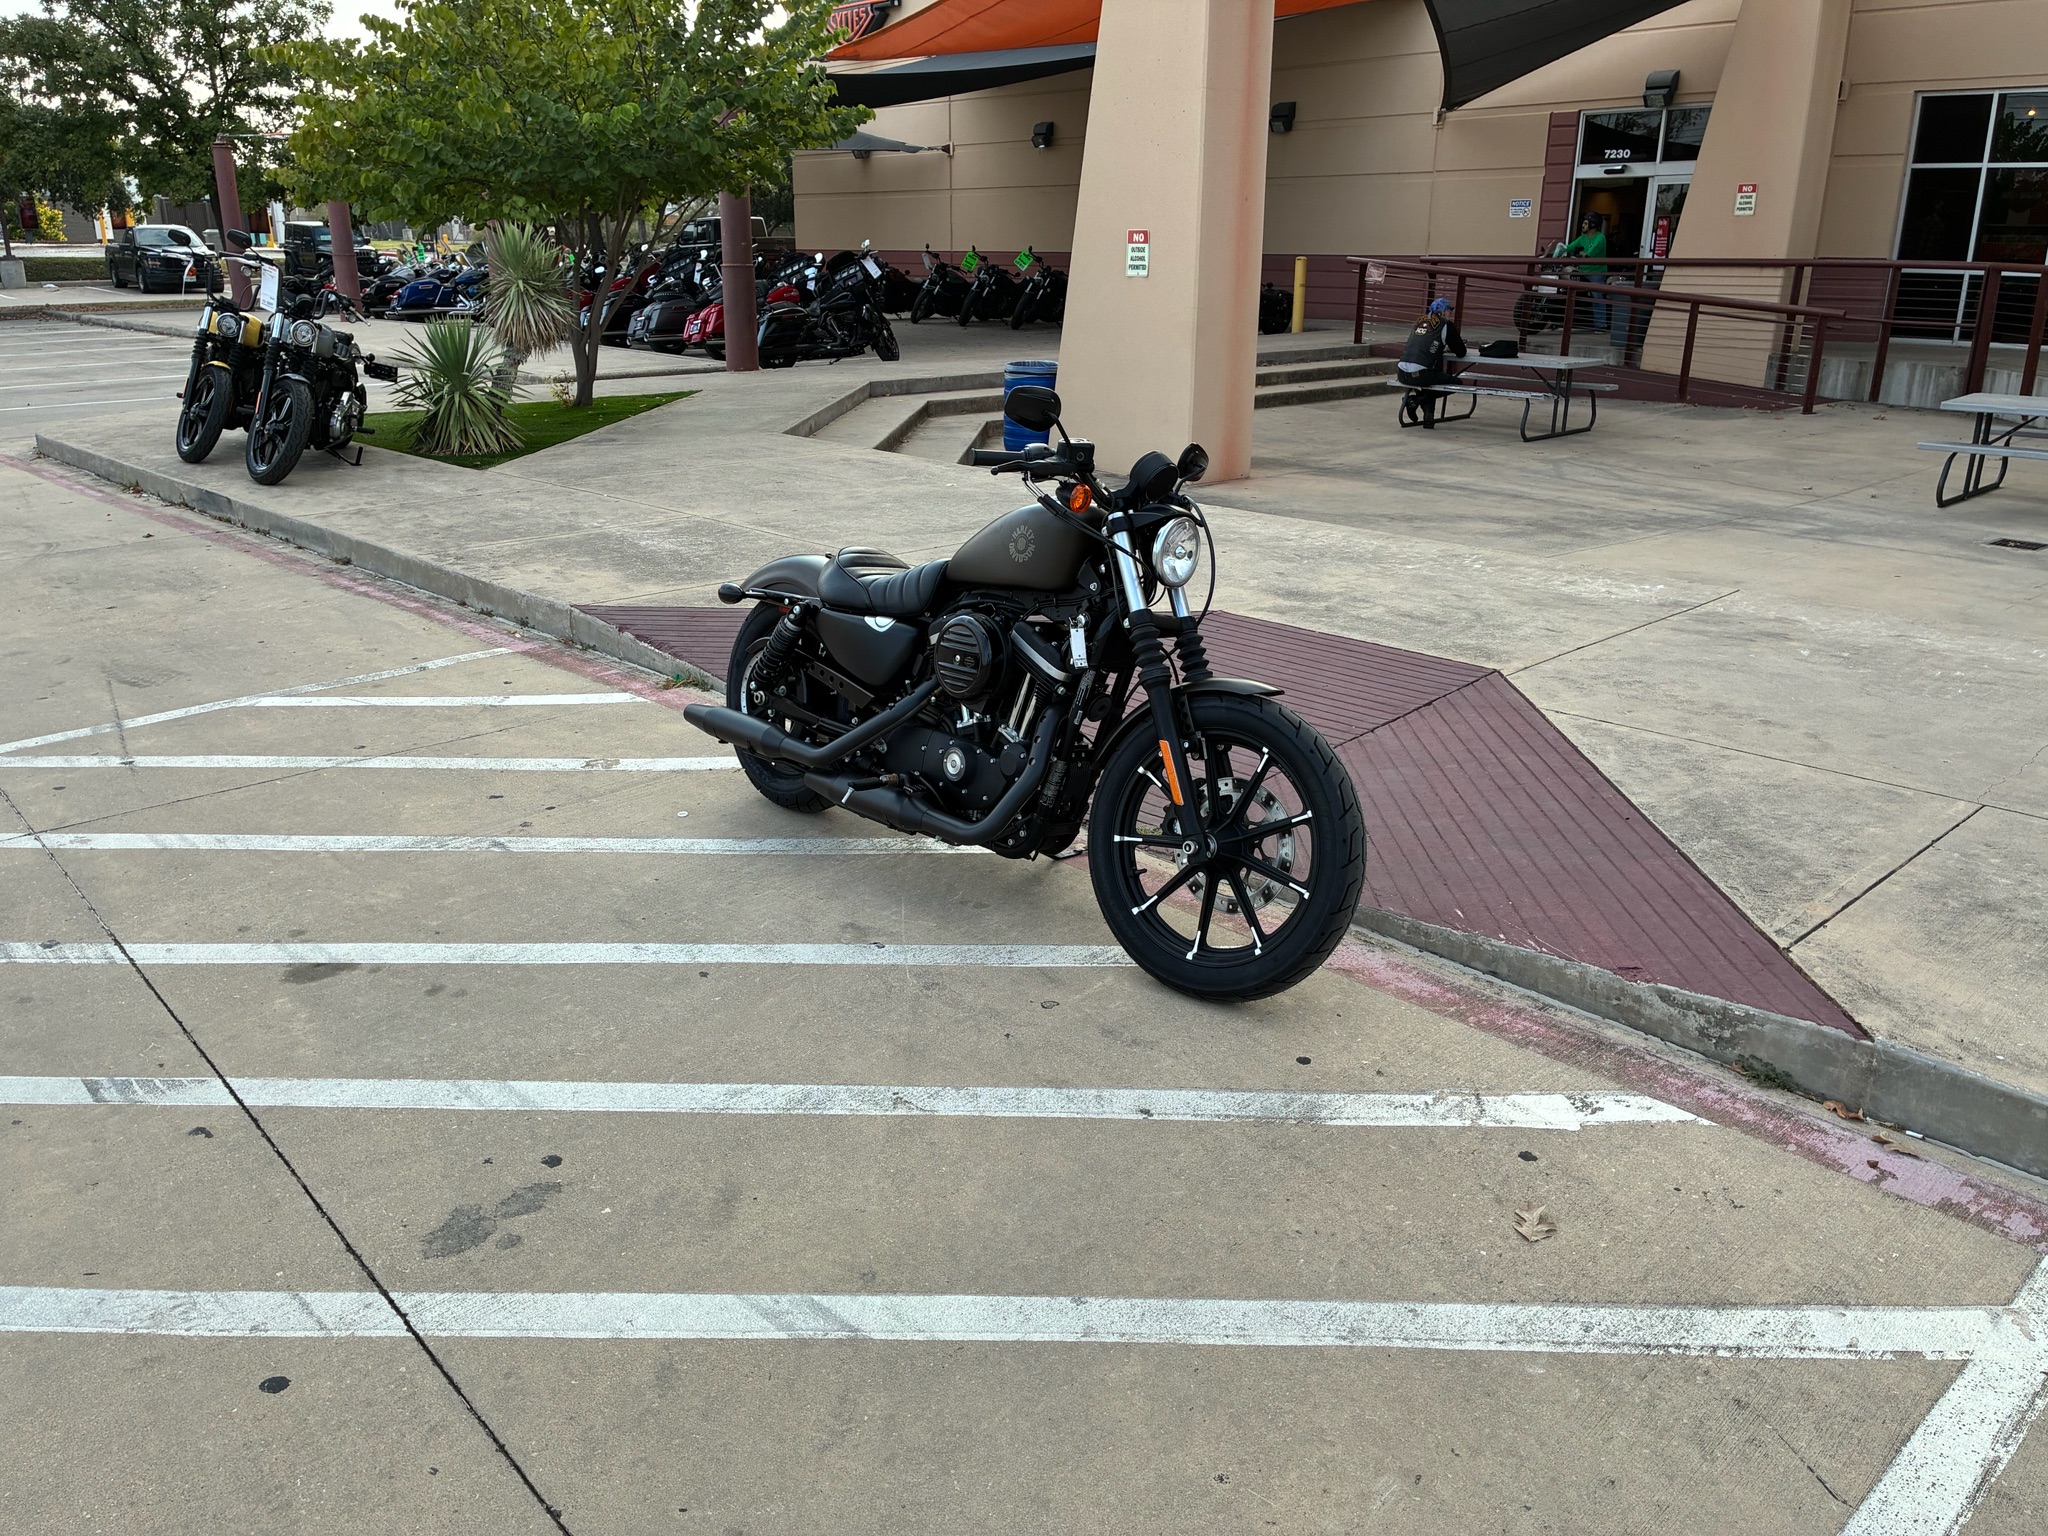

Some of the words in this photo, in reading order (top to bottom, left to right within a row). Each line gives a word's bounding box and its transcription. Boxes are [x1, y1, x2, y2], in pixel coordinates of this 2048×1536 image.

[1604, 149, 1630, 159] 7230
[1132, 233, 1145, 242] NO
[1011, 525, 1035, 540] HARLEY
[1008, 542, 1036, 563] DAVIDSON
